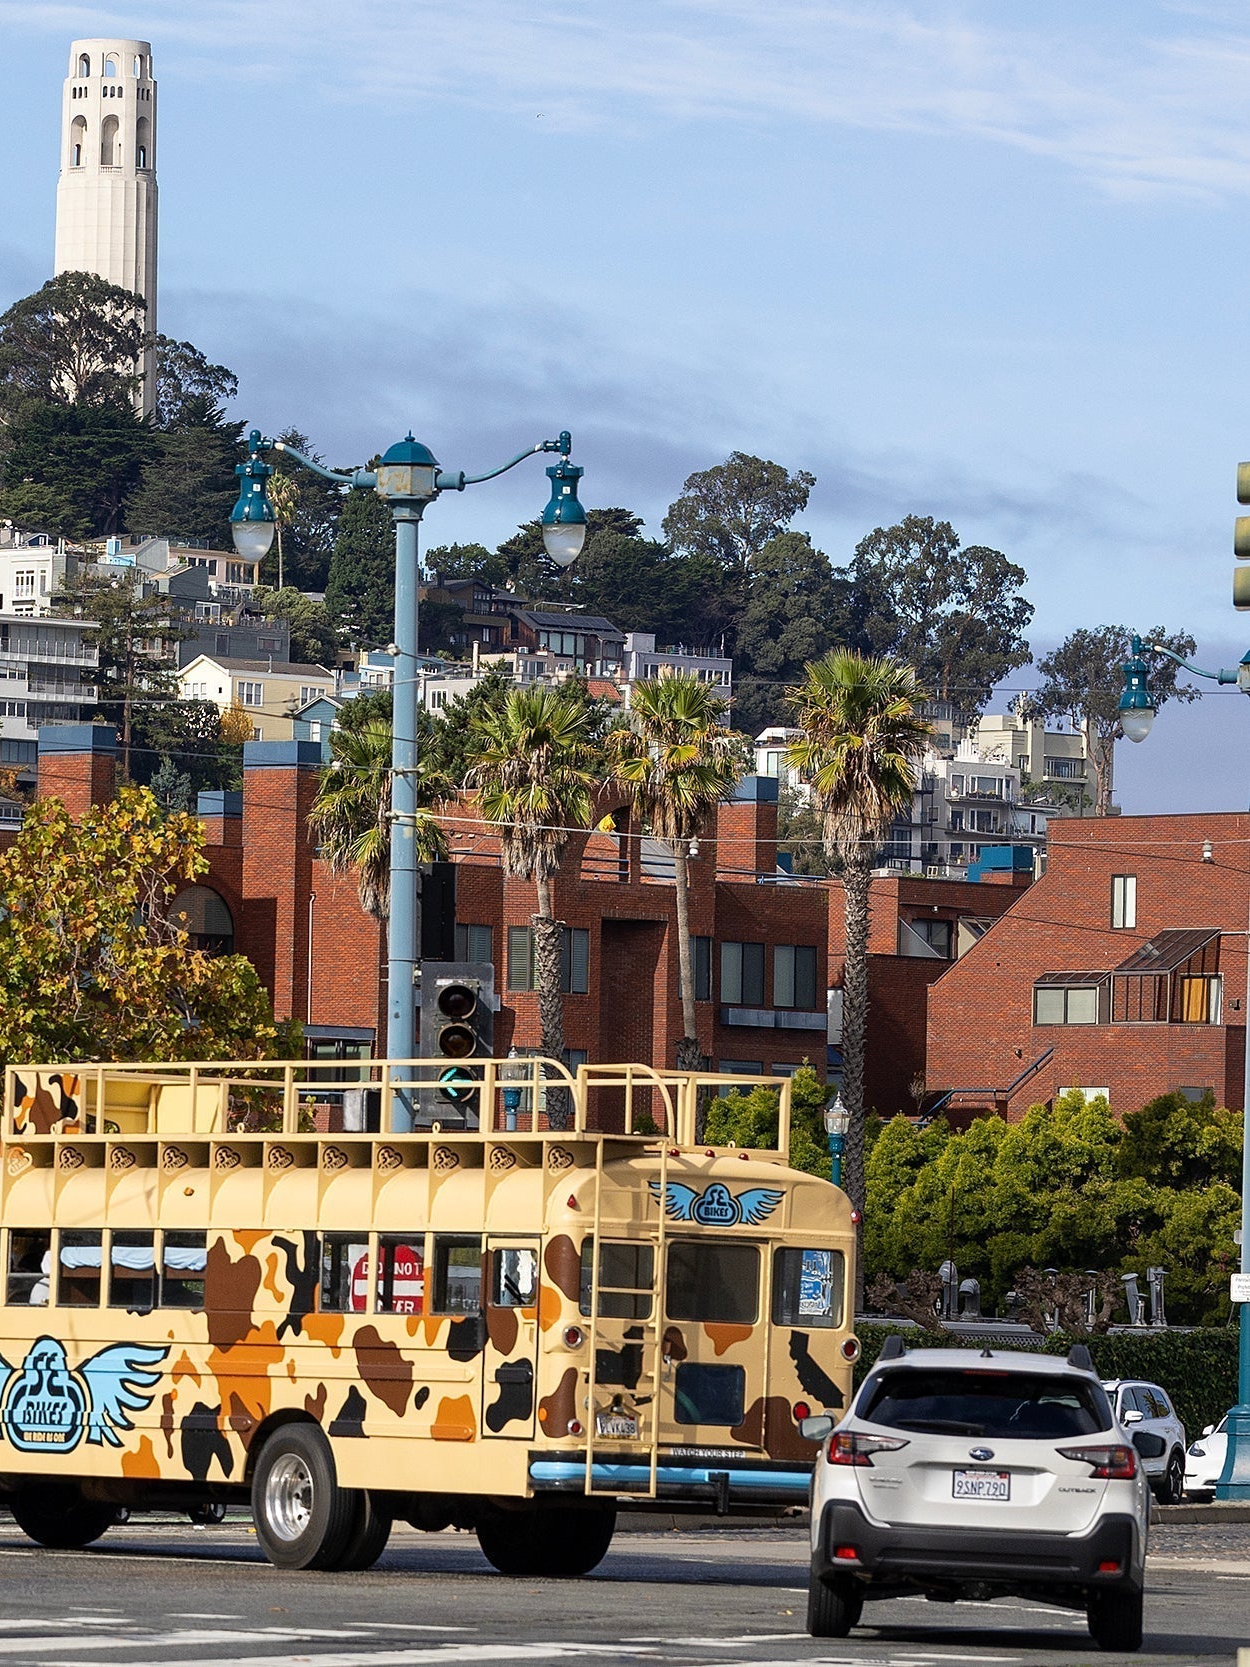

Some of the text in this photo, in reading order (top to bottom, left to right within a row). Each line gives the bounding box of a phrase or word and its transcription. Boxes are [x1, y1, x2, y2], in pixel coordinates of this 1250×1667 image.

[706, 1189, 727, 1206] SE
[704, 1207, 728, 1217] BIKES
[394, 1262, 422, 1276] NOT
[672, 1447, 744, 1458] WATCH YOUR STEP
